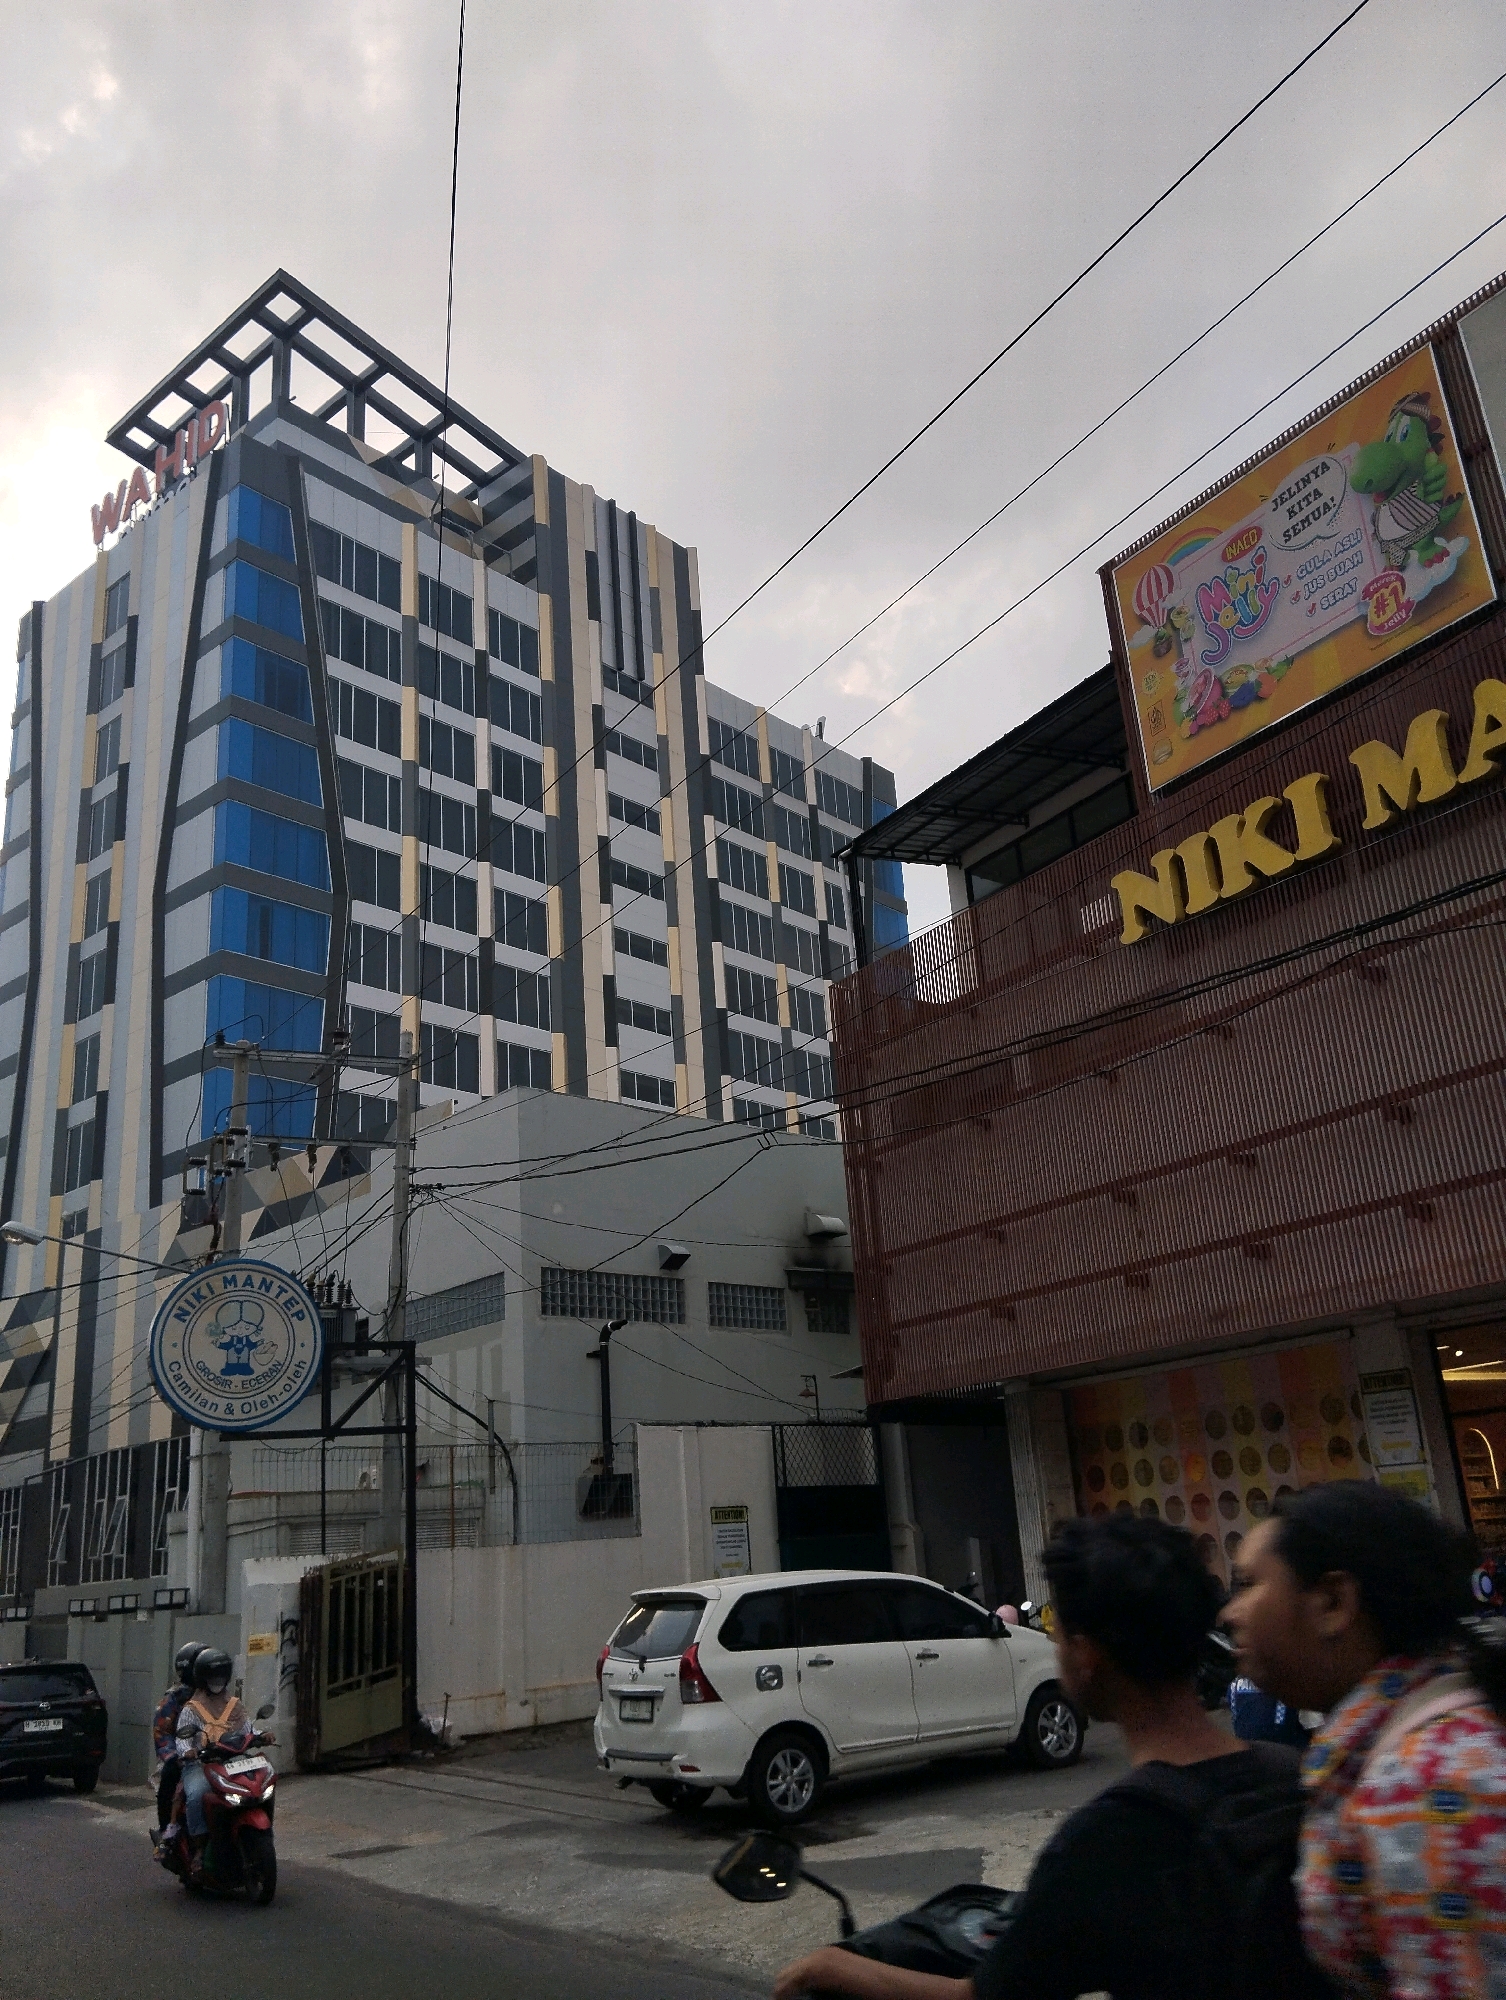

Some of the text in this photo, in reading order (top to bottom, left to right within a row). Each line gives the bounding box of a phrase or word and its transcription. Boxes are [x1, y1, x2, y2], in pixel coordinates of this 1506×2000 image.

[91, 400, 226, 545] WAHID
[1271, 461, 1331, 512] JELINYA
[1282, 496, 1337, 544] SEMUA!
[1286, 487, 1323, 520] KITA
[1225, 528, 1258, 560] INACO
[1334, 527, 1363, 558] ASLI
[1198, 548, 1266, 623] Mini
[1304, 550, 1363, 600] JUS BUAH
[1320, 576, 1358, 610] SERAT
[1201, 577, 1279, 665] Jelly
[1374, 584, 1403, 619] #1
[1110, 678, 1506, 945] NIKI MA
[173, 1274, 306, 1323] NIKI MANTEP
[168, 1359, 308, 1416] Camilan & Oleh-oleh
[195, 1360, 233, 1390] GROSIR
[241, 1360, 283, 1390] ECERAN
[714, 1509, 746, 1521] ATTENTION!
